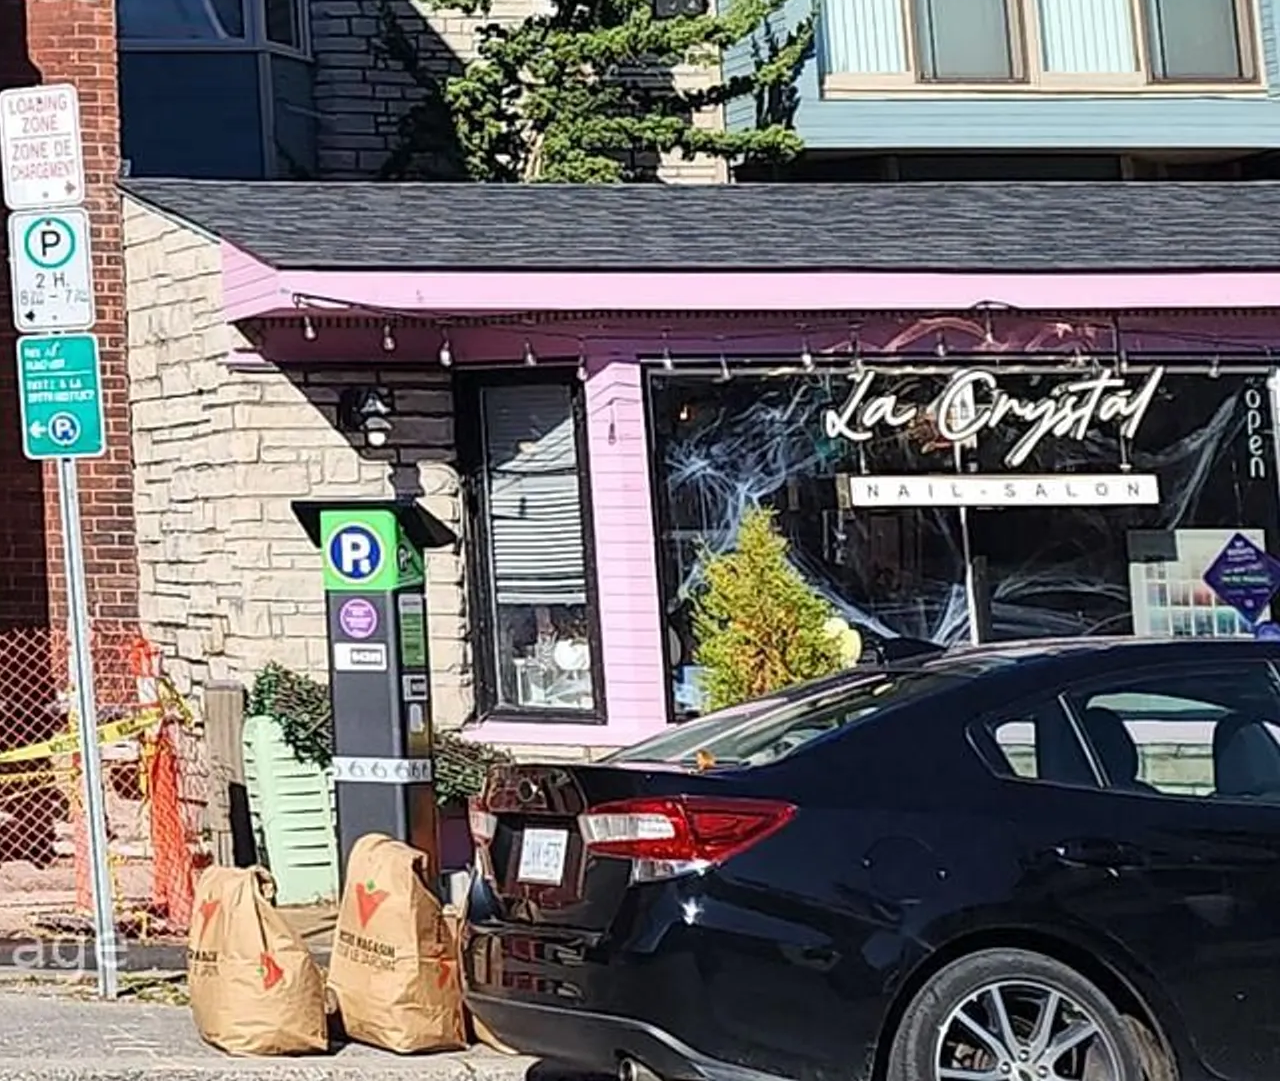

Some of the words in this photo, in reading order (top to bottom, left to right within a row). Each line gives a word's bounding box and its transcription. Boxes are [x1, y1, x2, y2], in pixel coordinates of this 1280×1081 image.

[8, 94, 67, 115] LOADING
[21, 114, 59, 134] ZONE
[11, 142, 49, 161] ZONE
[54, 140, 73, 158] DE
[41, 230, 61, 257] P
[35, 273, 45, 288] 2
[825, 370, 917, 441] La
[938, 365, 1164, 468] Crystal
[1245, 388, 1266, 479] open
[340, 532, 372, 574] P
